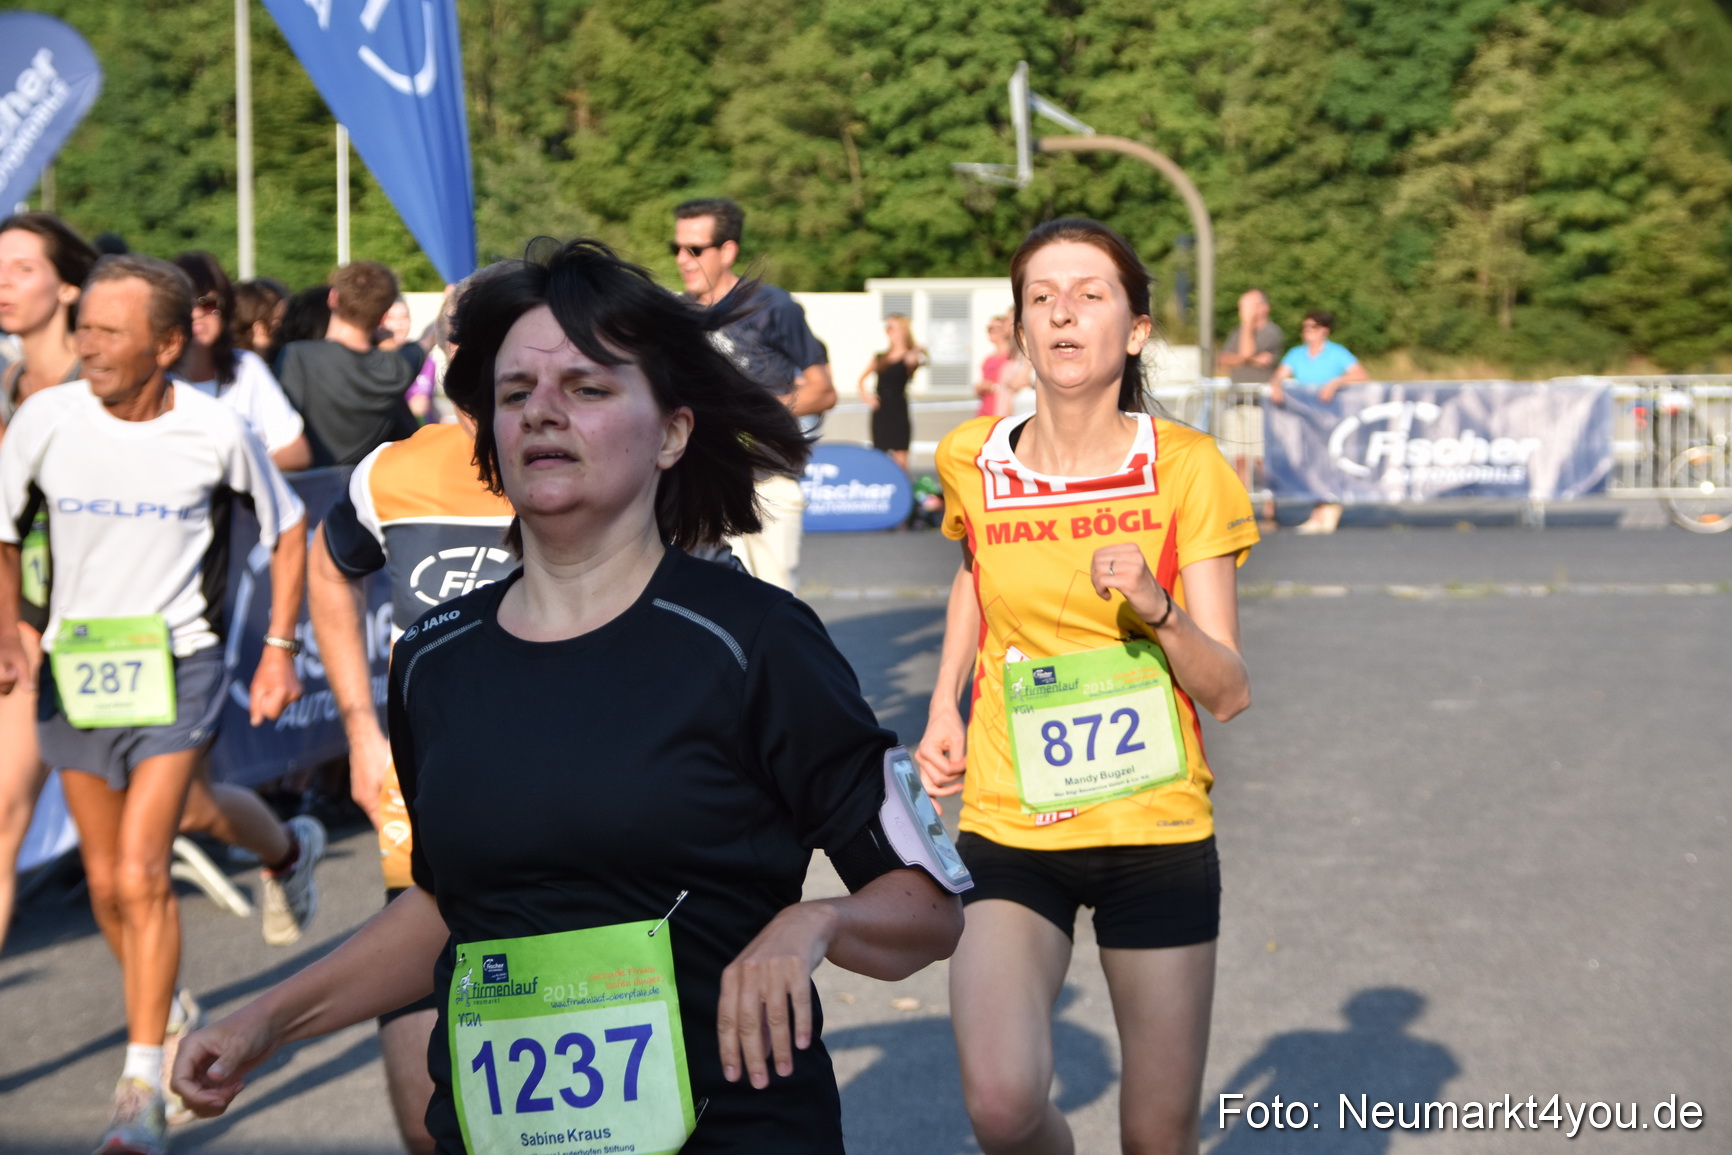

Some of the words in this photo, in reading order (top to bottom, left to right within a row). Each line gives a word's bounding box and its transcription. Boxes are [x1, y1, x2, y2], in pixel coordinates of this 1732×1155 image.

[1365, 429, 1541, 468] Fischer
[985, 519, 1059, 545] MAX
[1070, 508, 1162, 540] BÖGL
[422, 609, 460, 632] JAKO
[76, 661, 142, 694] 287
[1025, 678, 1080, 697] firmenlauf
[1082, 679, 1114, 695] 2015
[1041, 707, 1146, 767] 872
[1064, 774, 1098, 786] Mandy
[1100, 765, 1135, 780] Bugzel
[472, 976, 538, 998] firmenlauf
[543, 982, 589, 1003] 2015
[471, 1023, 654, 1115] 1237
[520, 1130, 565, 1147] Sabine
[567, 1128, 611, 1143] Kraus
[604, 1144, 635, 1153] Stiftung
